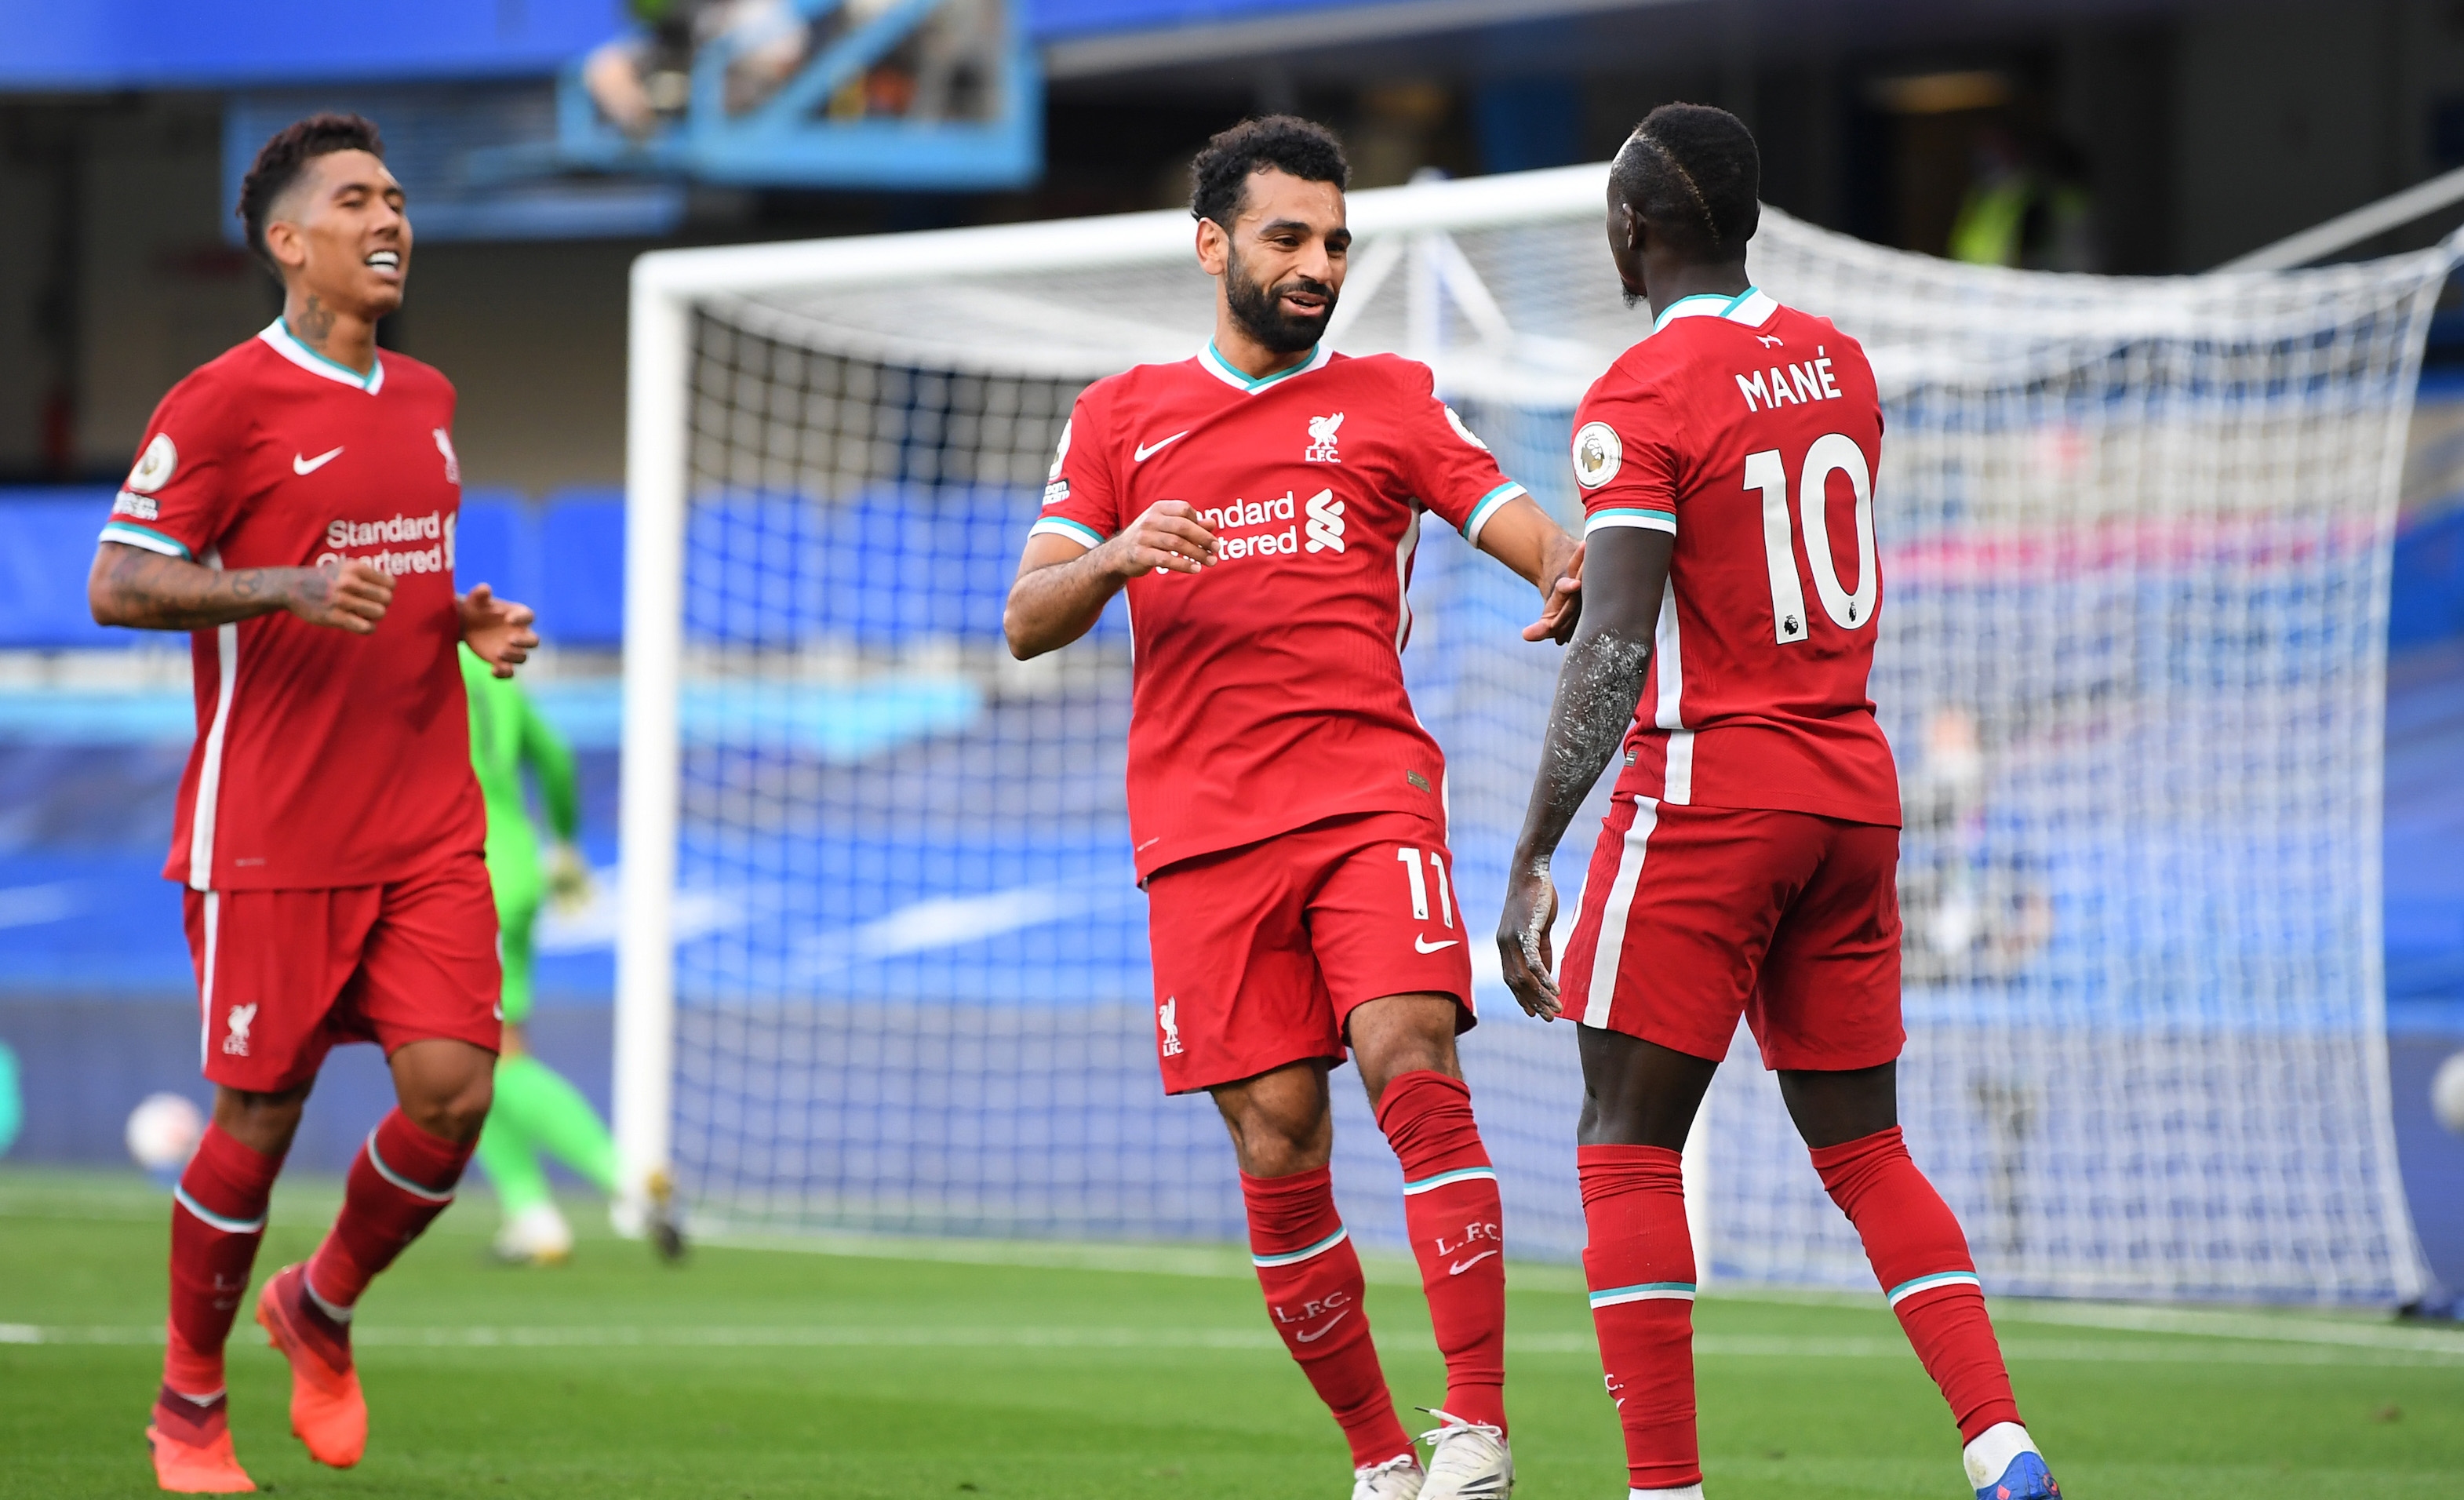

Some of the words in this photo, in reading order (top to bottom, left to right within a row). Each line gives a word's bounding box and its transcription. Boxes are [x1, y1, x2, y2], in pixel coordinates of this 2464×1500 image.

[1735, 345, 1843, 413] MANÉ
[326, 510, 440, 548] Standard
[1196, 490, 1295, 530] ndard
[1743, 433, 1878, 645] 10
[1397, 847, 1454, 929] 11
[1435, 1221, 1501, 1257] L.F.C.
[1275, 1291, 1352, 1323] L.F.C.
